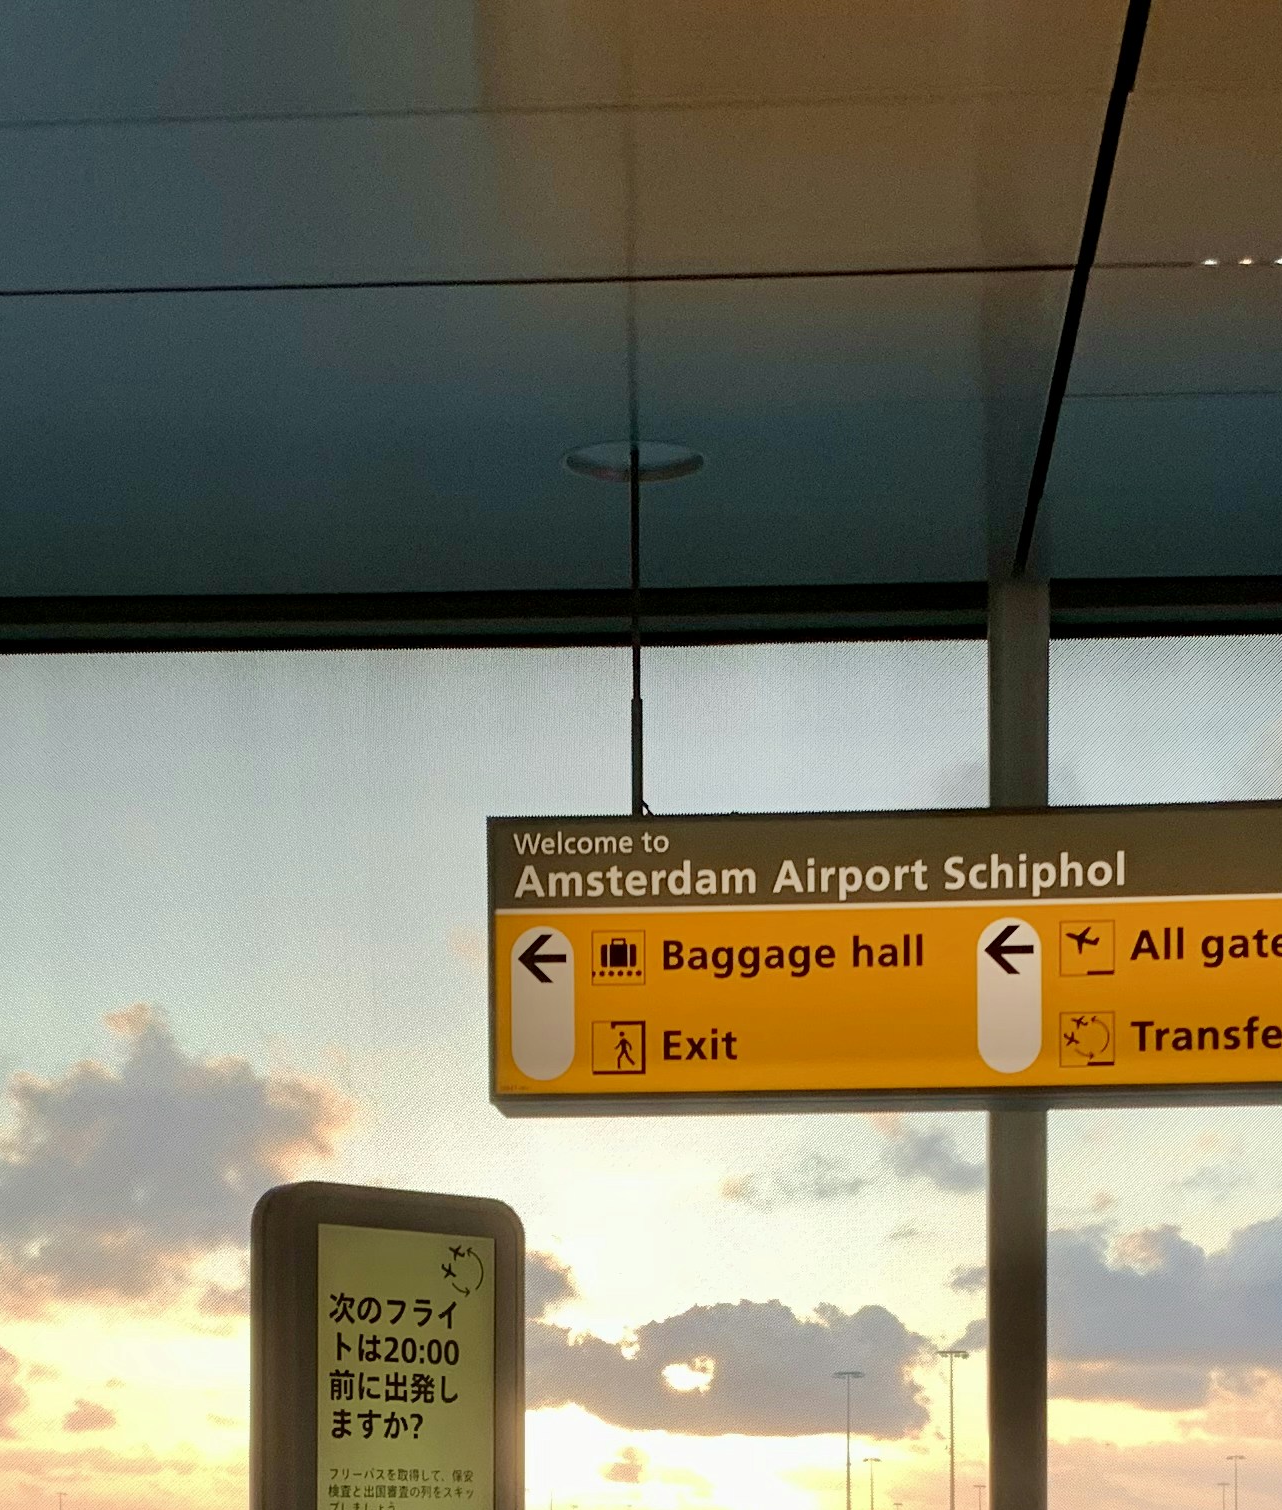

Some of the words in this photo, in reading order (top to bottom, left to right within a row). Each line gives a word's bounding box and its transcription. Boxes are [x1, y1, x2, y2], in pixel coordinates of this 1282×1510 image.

[513, 831, 633, 855] Welcome
[641, 832, 670, 853] to
[514, 860, 757, 898] Amsterdam
[772, 858, 928, 901] Airport
[944, 850, 1125, 897] Schiphol
[663, 939, 836, 978] Baggage
[852, 934, 923, 967] hall
[1130, 927, 1184, 961] All
[663, 1028, 738, 1061] Exit
[329, 1292, 458, 1330] 次のフライ
[336, 1332, 460, 1366] トは20:00
[329, 1369, 459, 1404] 前に出発し
[331, 1408, 424, 1439] ますか?
